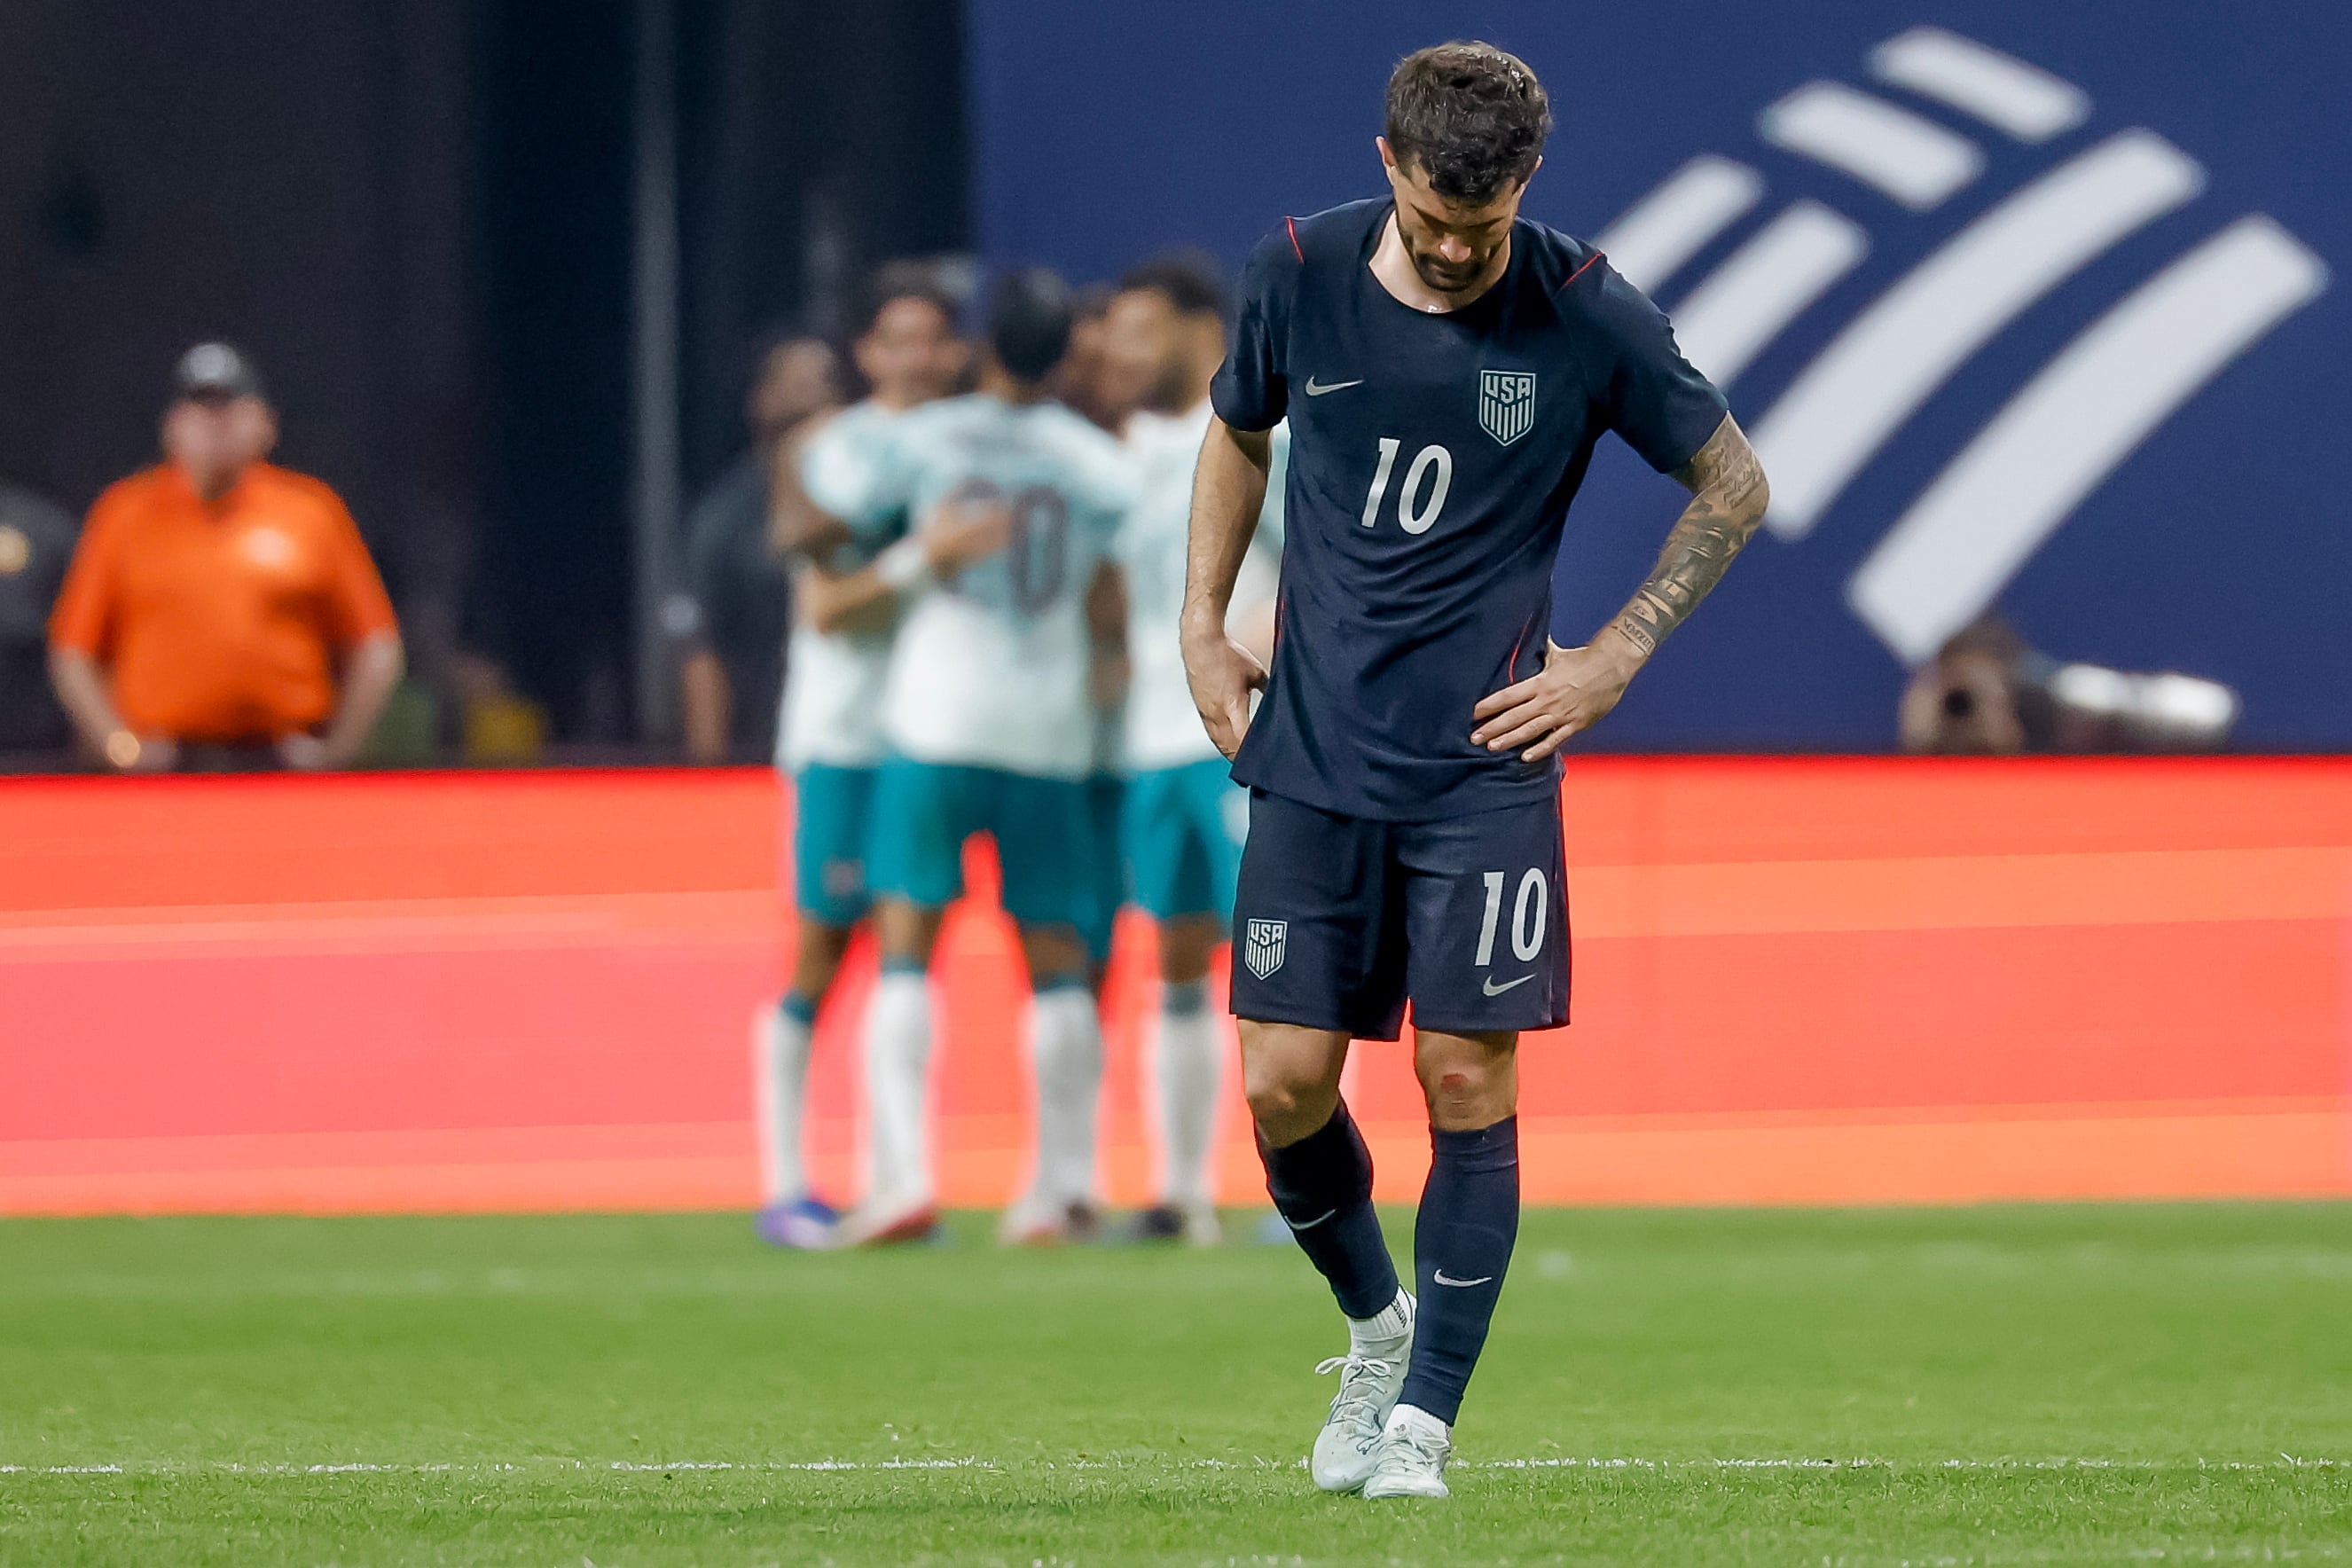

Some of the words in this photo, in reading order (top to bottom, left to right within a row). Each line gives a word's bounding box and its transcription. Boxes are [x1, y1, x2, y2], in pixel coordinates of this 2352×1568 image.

[1485, 374, 1532, 404] USA
[1361, 437, 1453, 535] 10
[1250, 923, 1283, 946] USA
[1475, 867, 1548, 966] 10
